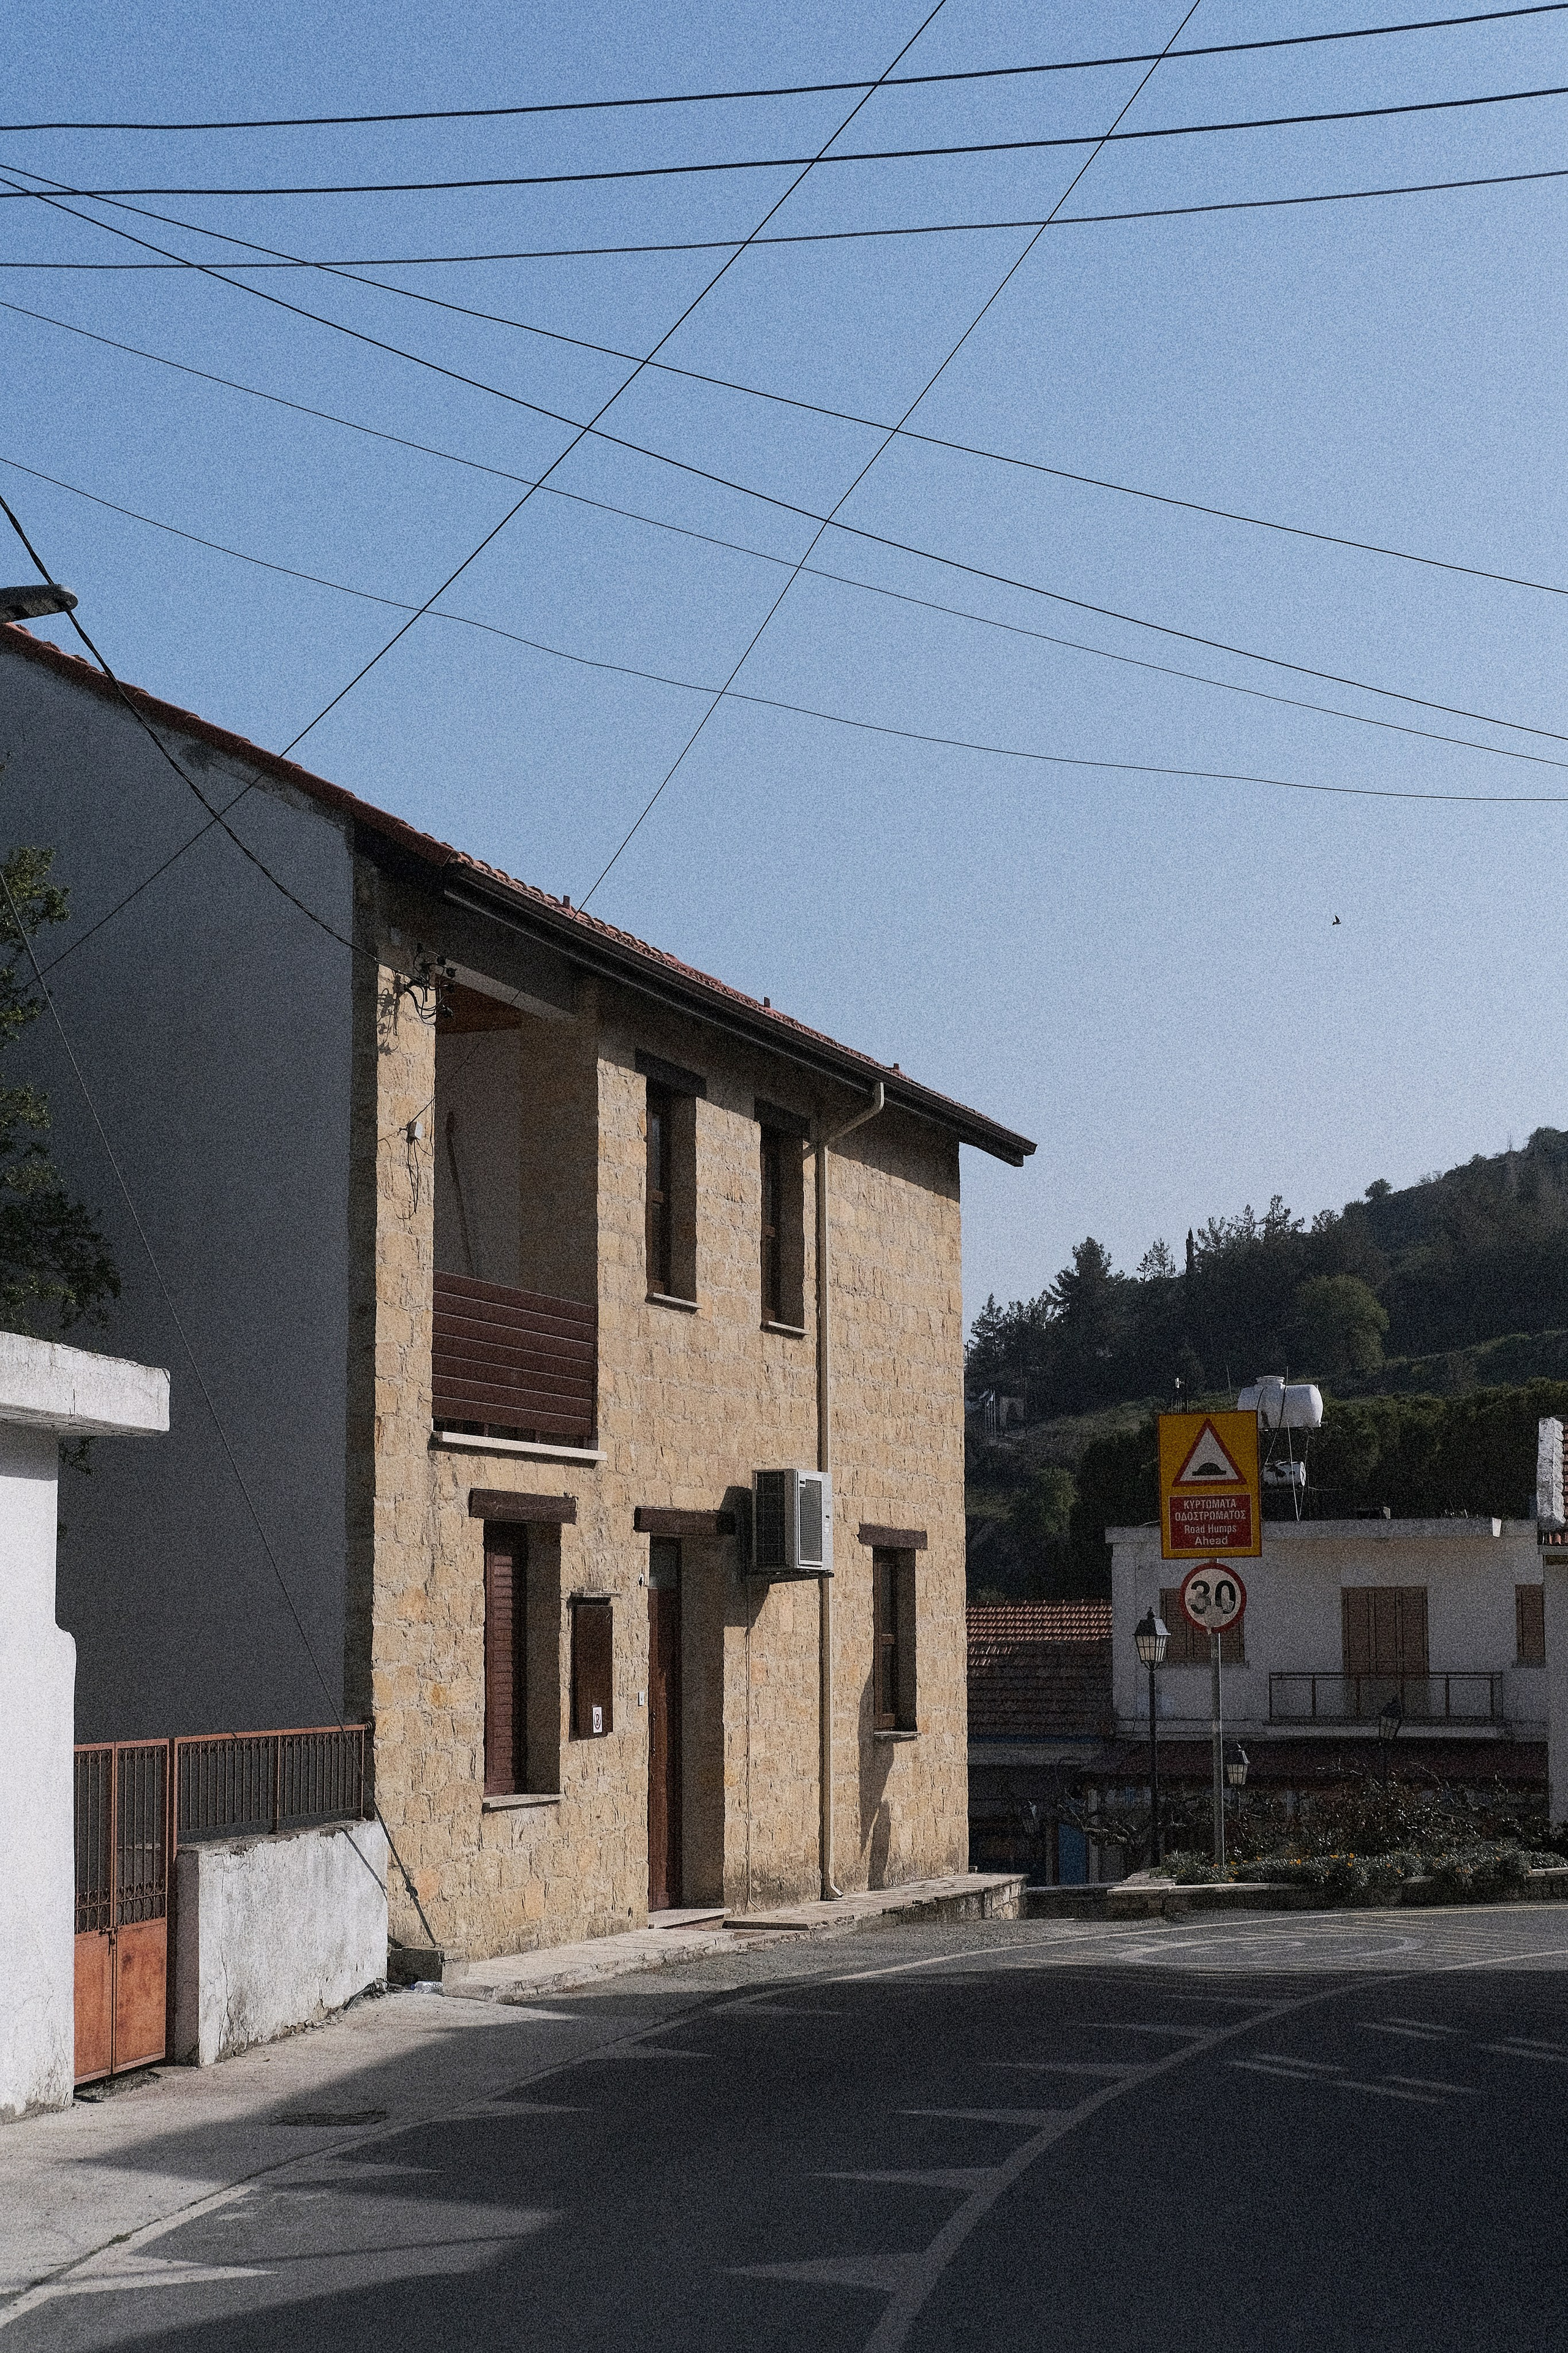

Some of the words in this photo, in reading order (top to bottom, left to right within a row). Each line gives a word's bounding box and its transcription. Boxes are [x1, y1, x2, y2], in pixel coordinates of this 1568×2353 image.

[1184, 1499, 1237, 1509] ΚΥΡΤΩΜΑΤΑ
[1175, 1510, 1246, 1521] ΟΔΟΣΤΡΩΜΑΤΟΣ
[1184, 1525, 1205, 1534] Road
[1208, 1524, 1237, 1535] Humps
[1195, 1536, 1229, 1546] Ahead
[1191, 1580, 1236, 1615] 30
